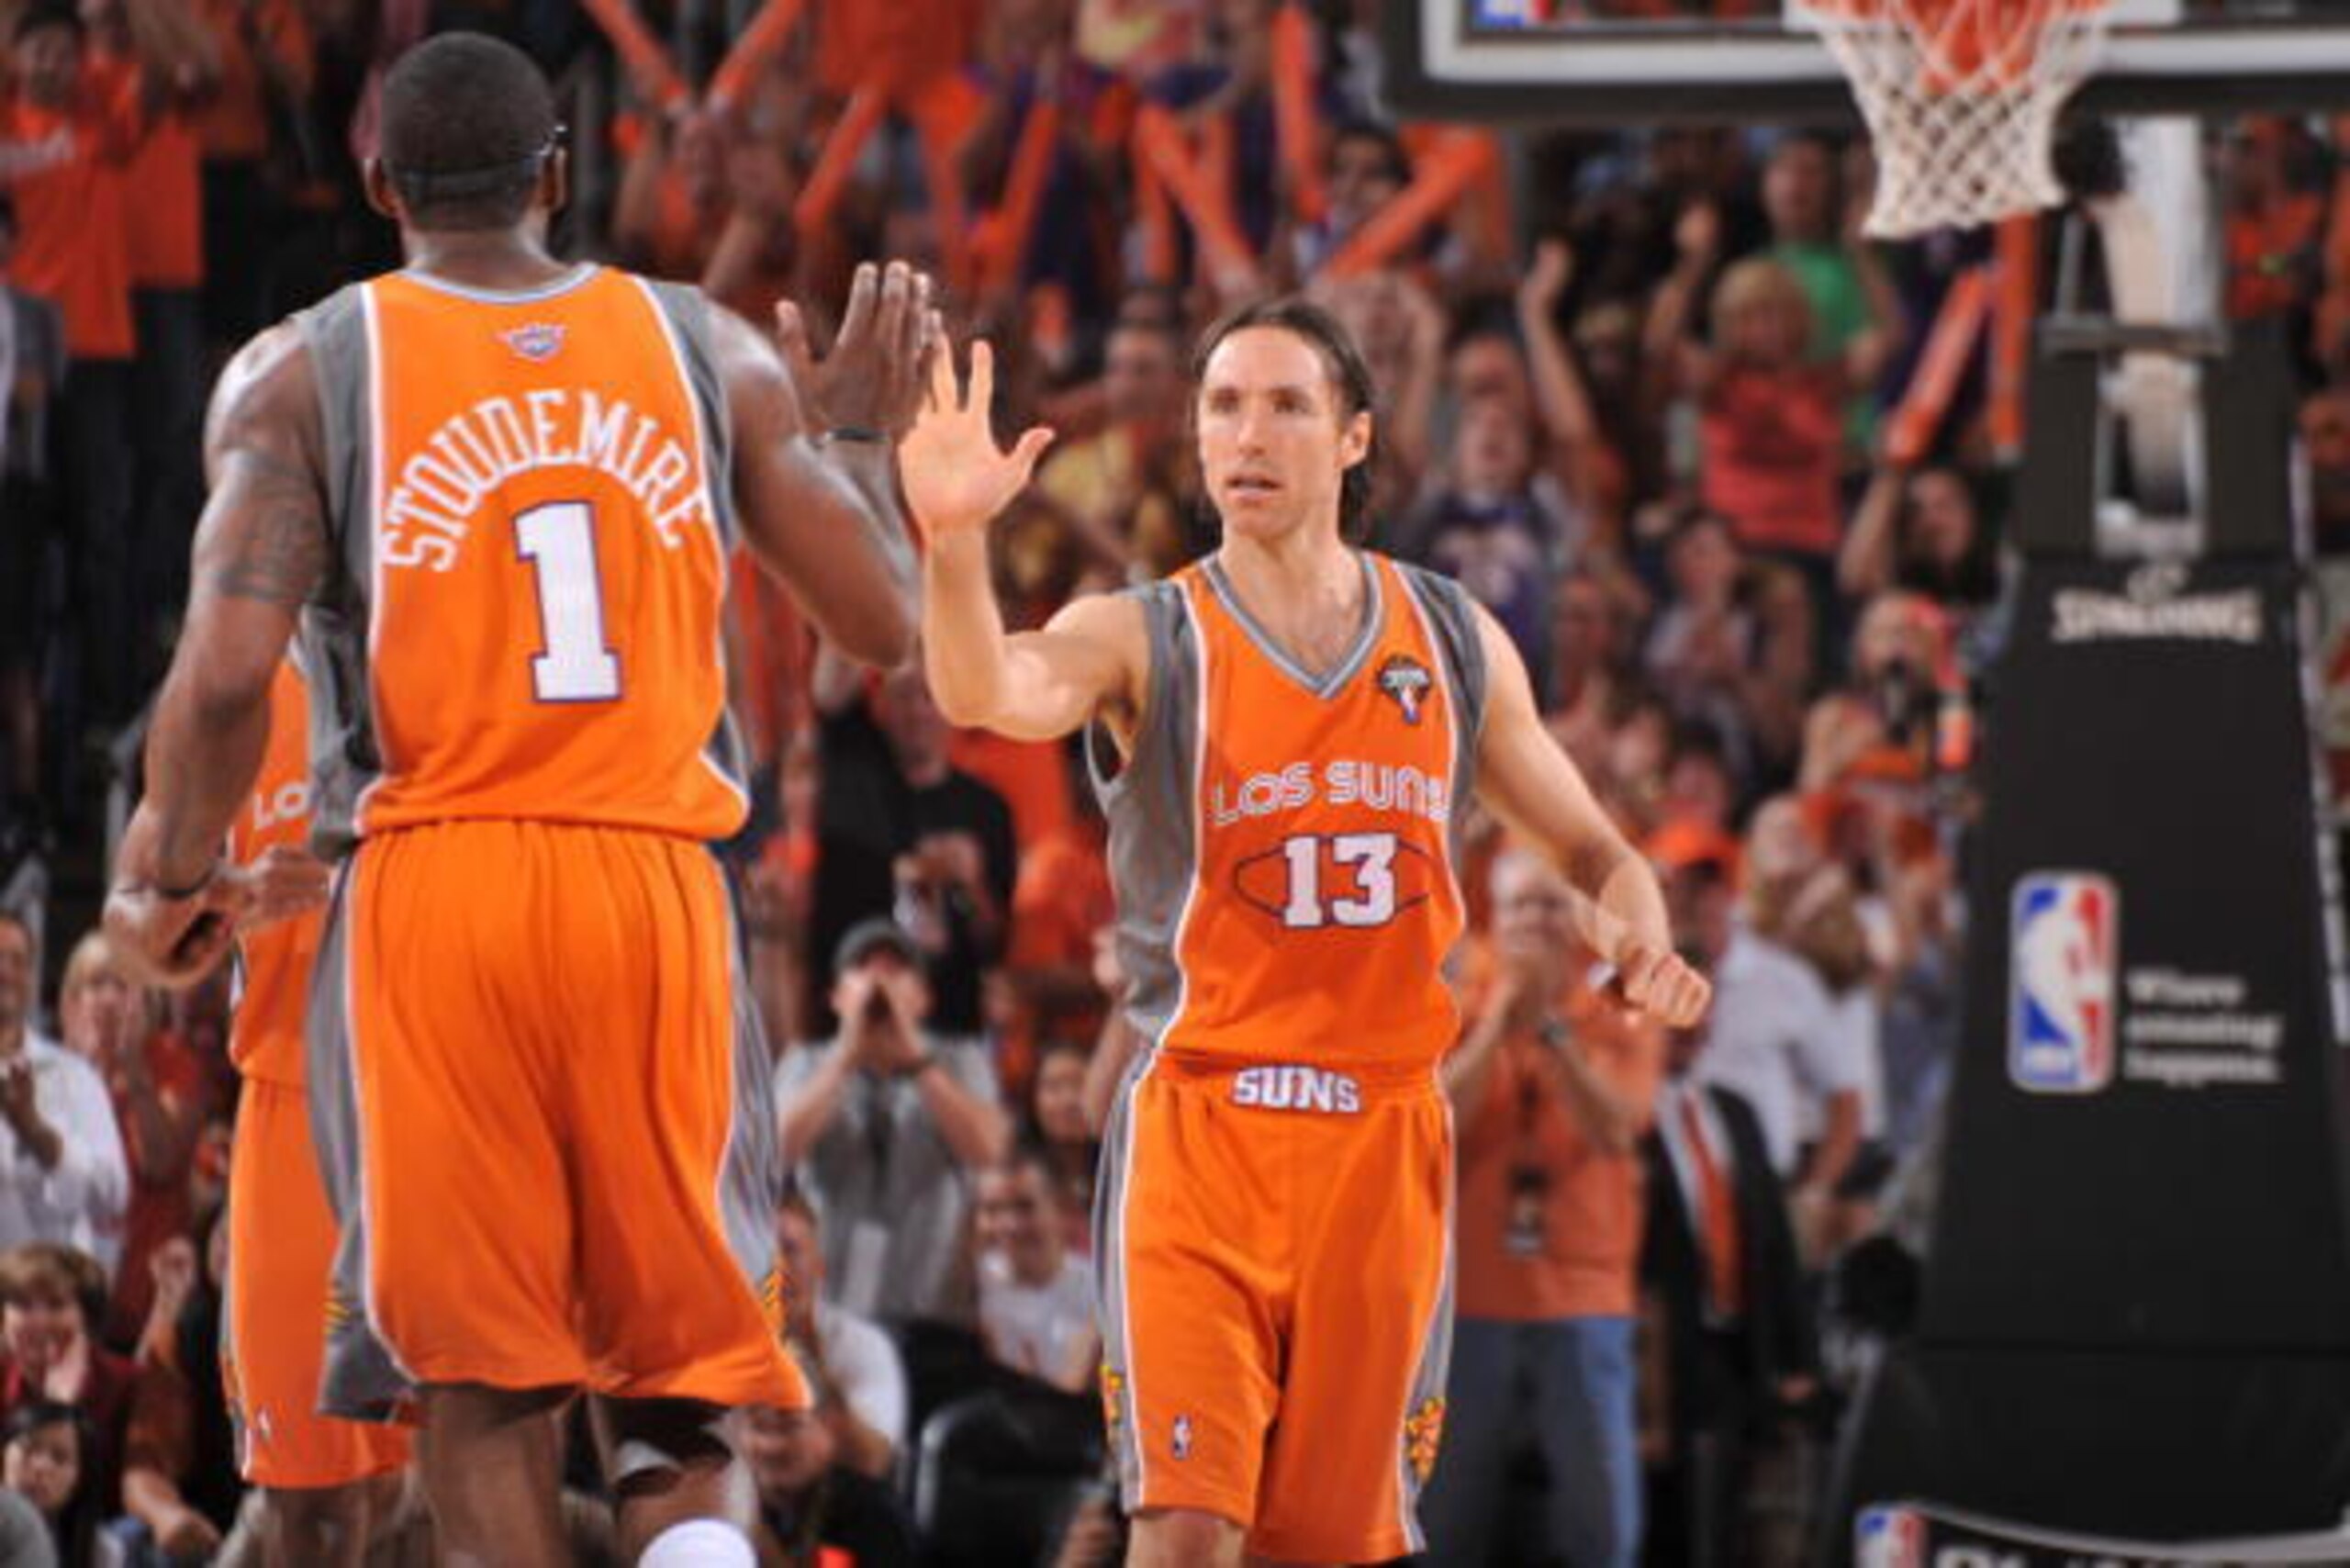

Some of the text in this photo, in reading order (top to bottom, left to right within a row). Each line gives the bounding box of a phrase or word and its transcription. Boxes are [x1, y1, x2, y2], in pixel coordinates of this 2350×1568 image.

[381, 388, 711, 573] STOUDEMIRE
[512, 499, 624, 705] 1
[253, 784, 311, 830] LO
[1209, 762, 1313, 826] LOS
[1282, 831, 1398, 928] 13
[1232, 1063, 1361, 1114] SUNS
